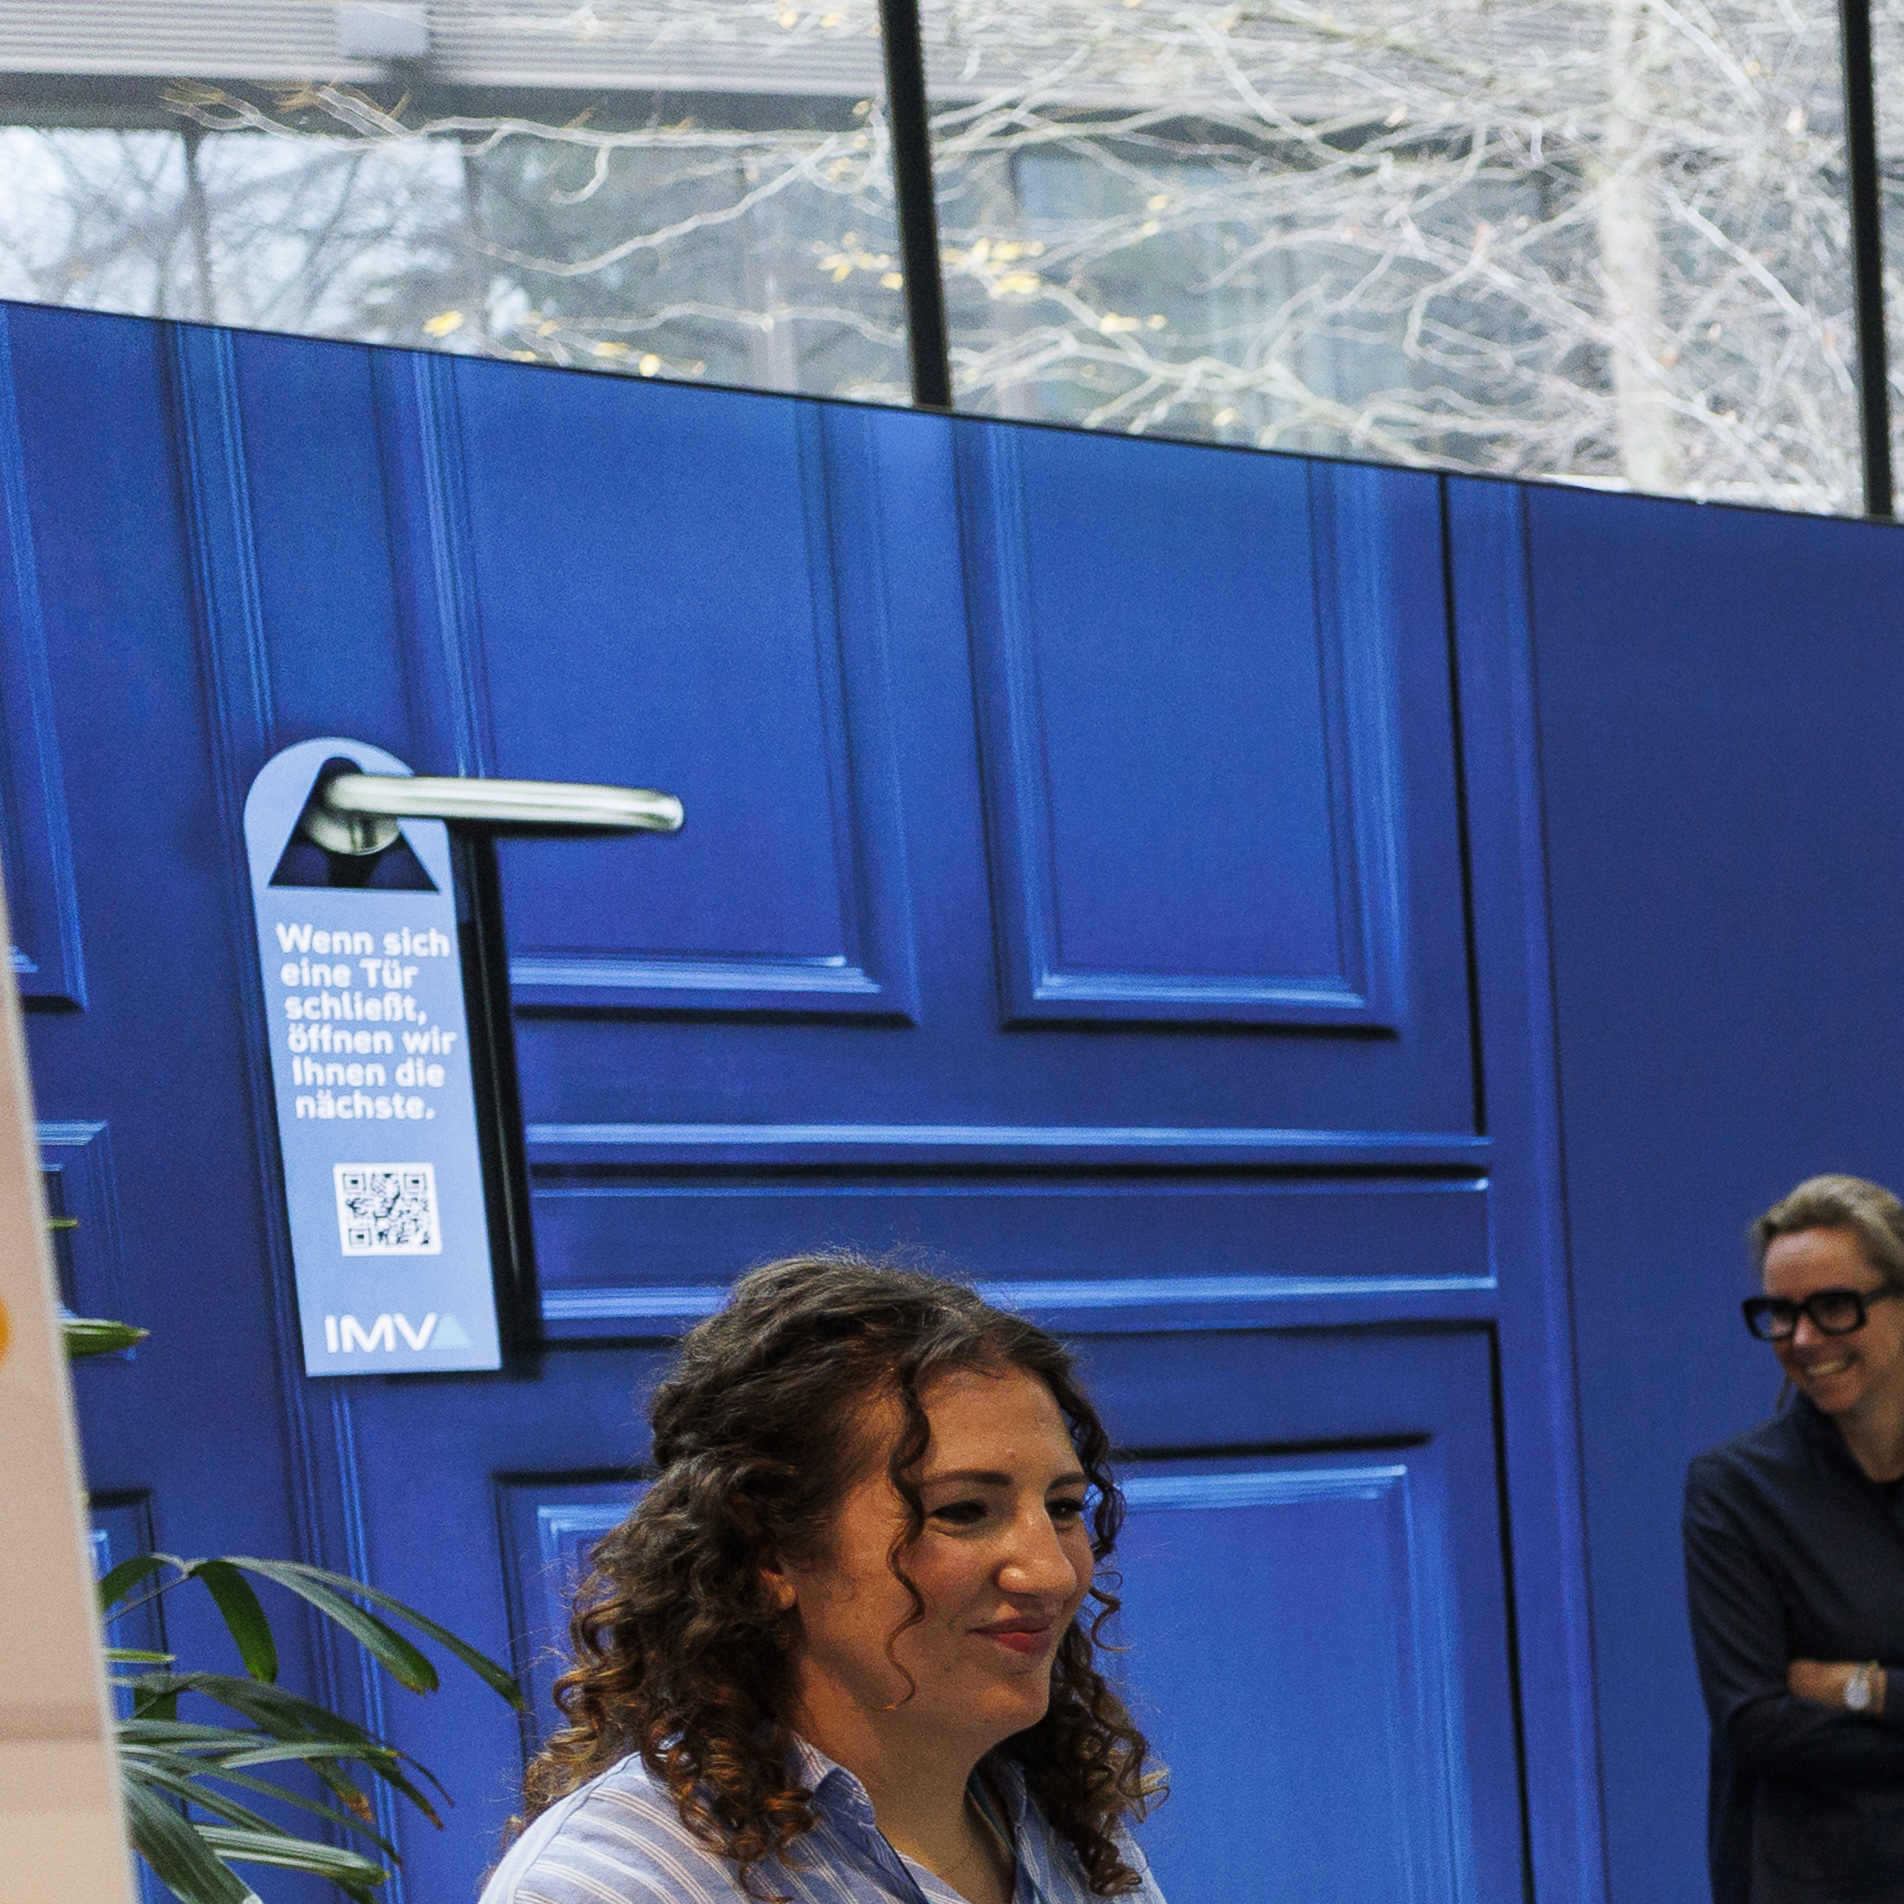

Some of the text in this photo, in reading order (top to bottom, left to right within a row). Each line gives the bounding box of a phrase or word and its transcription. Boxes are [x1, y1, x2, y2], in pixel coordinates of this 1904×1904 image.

[275, 922, 451, 957] Wenn sich
[280, 957, 420, 989] eine Tür
[284, 990, 428, 1027] schließt,
[287, 1023, 458, 1055] öffnen wir
[292, 1055, 446, 1088] Ihnen die
[295, 1089, 436, 1120] nächste.
